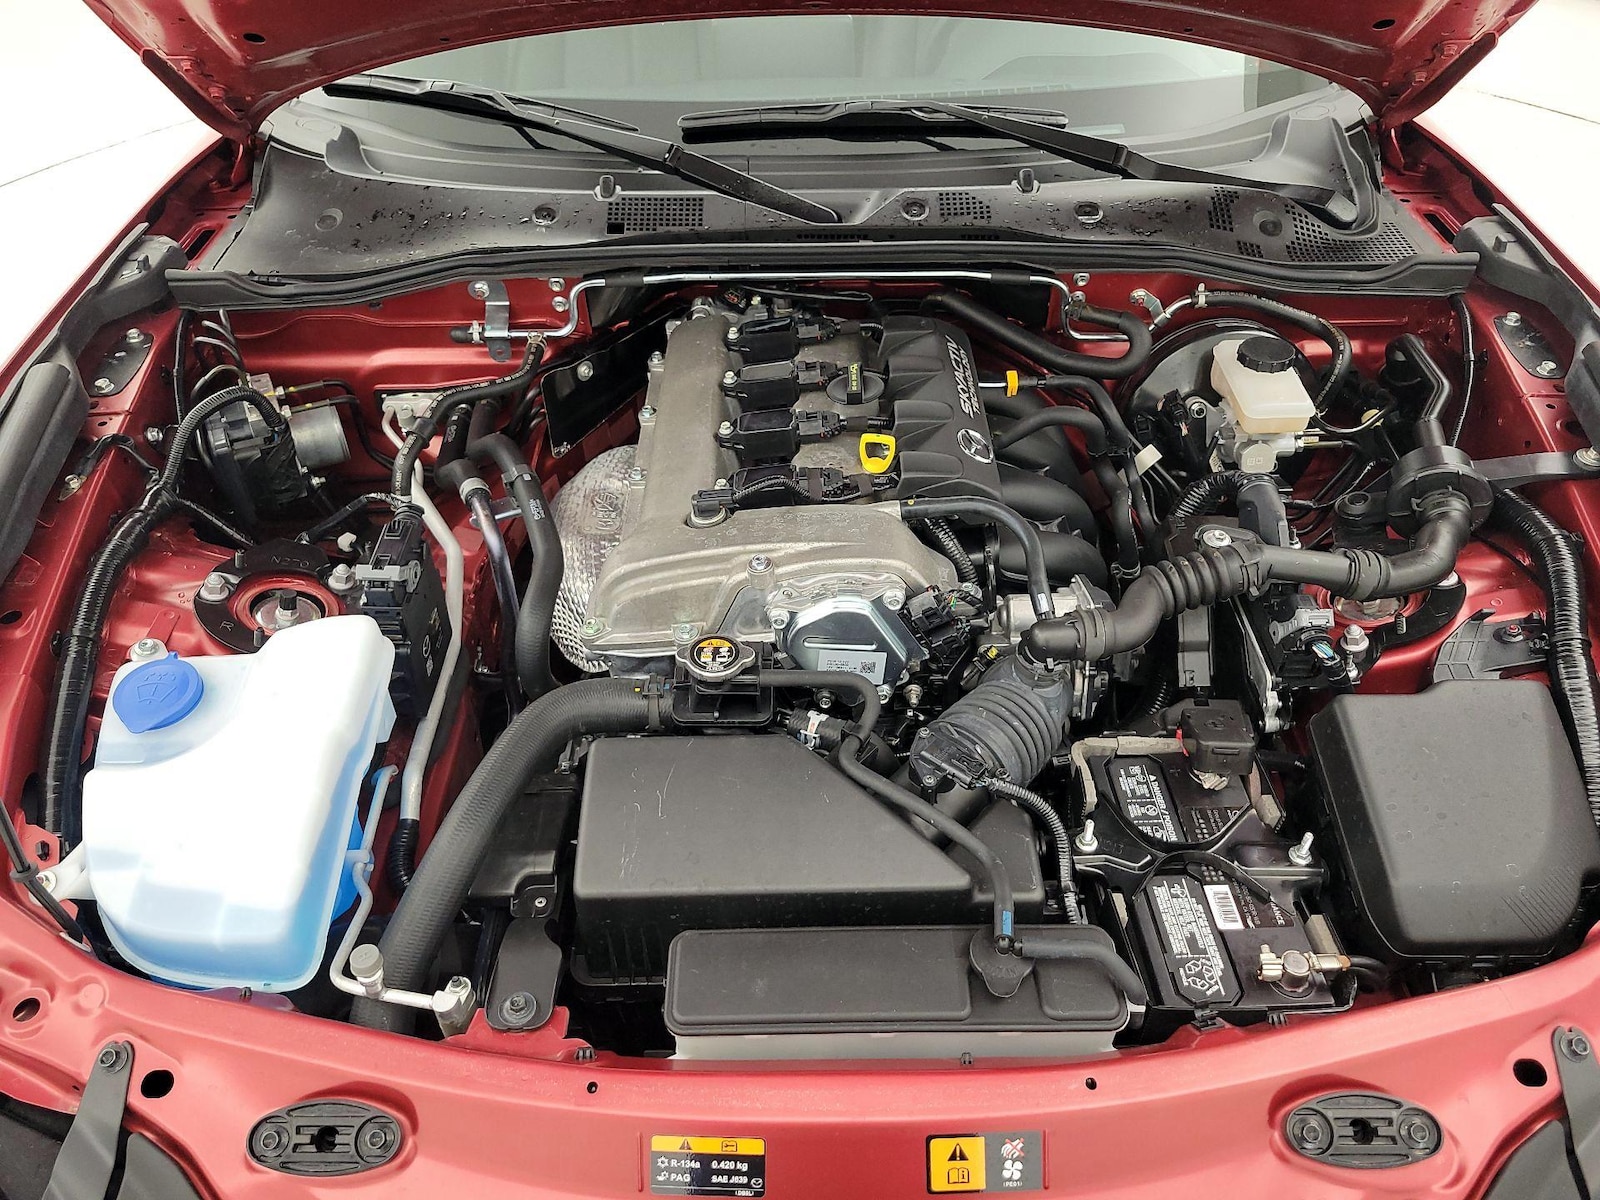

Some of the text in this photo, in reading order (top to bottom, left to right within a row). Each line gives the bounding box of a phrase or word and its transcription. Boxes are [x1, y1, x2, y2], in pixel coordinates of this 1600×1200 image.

[945, 335, 974, 419] SKYACTIV
[958, 345, 980, 414] TECHNOLOGY
[1151, 782, 1166, 809] DANGER
[1163, 815, 1178, 841] POISON
[670, 1160, 748, 1171] R-134a 0.420 kg
[670, 1173, 691, 1182] PAG
[711, 1175, 728, 1183] SAE
